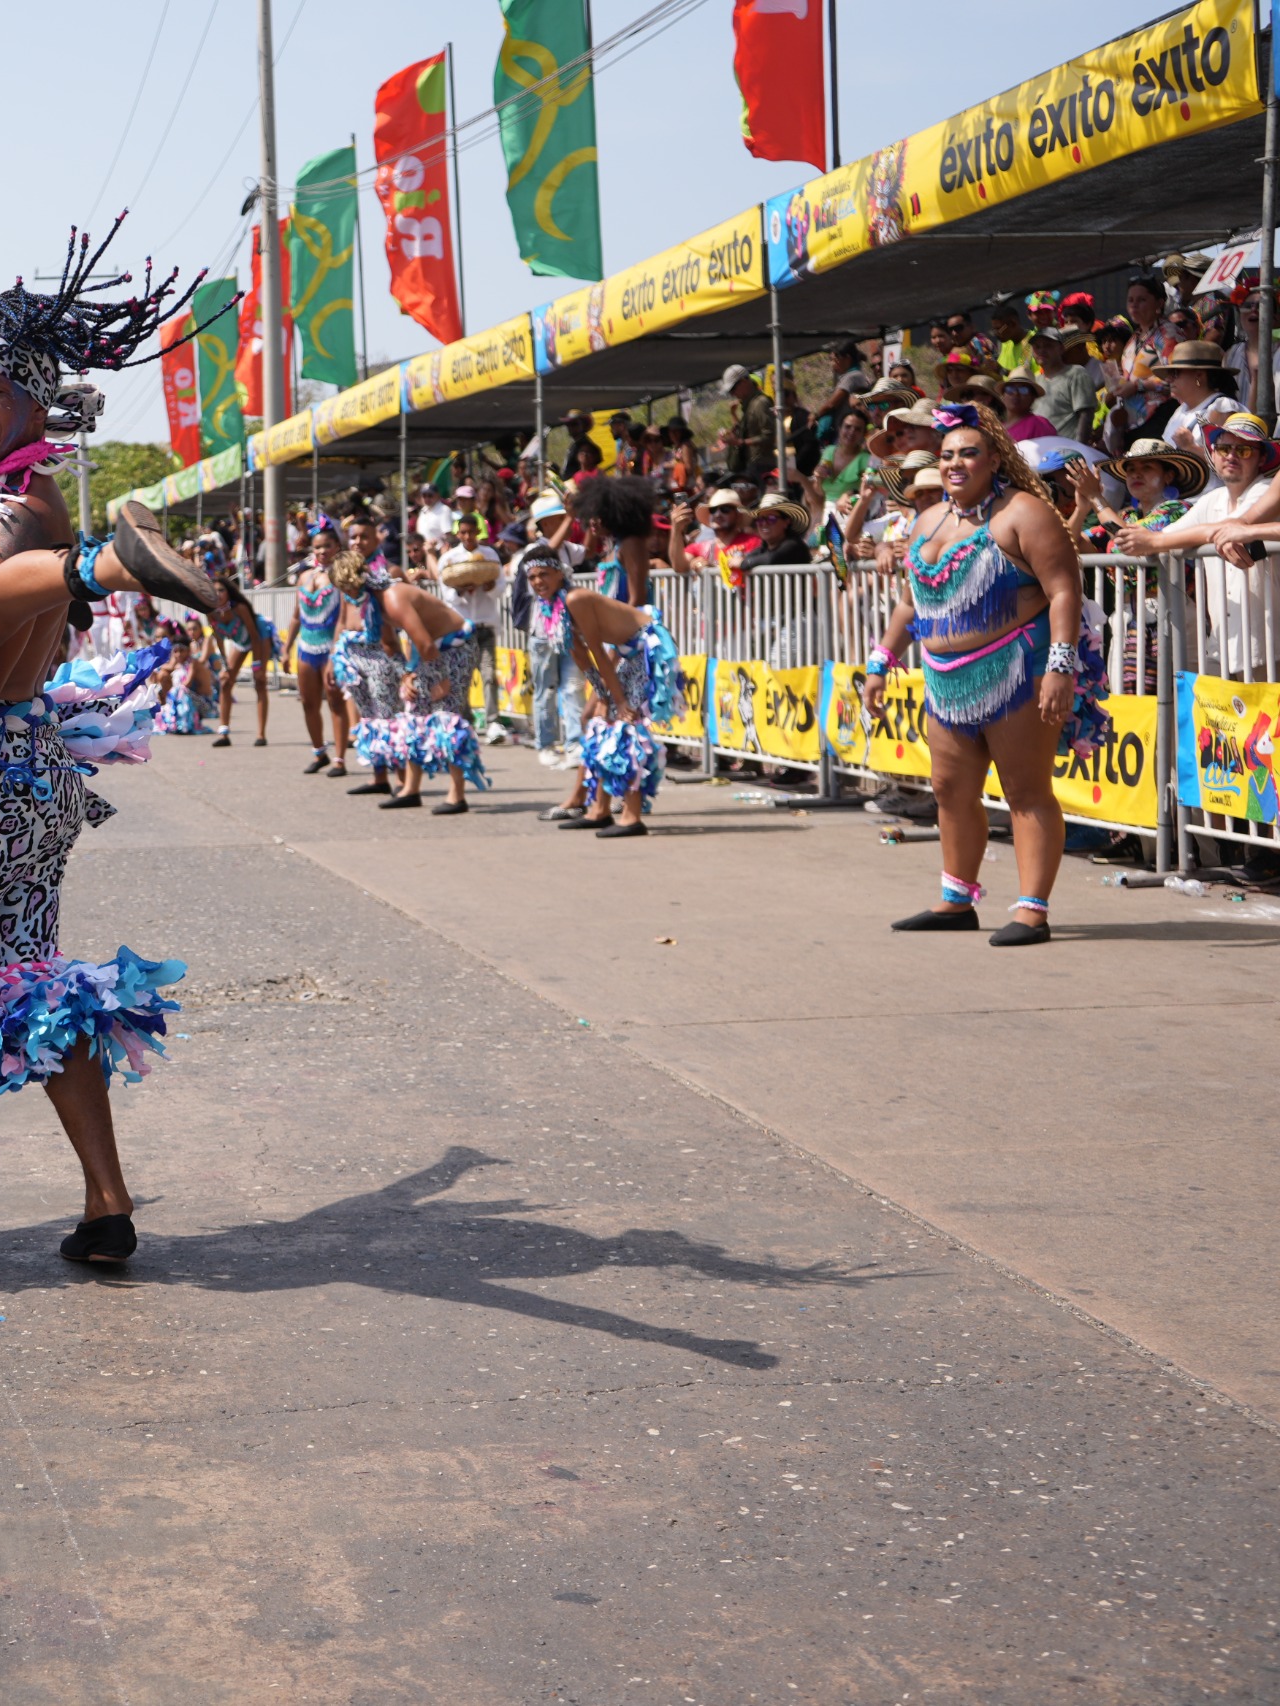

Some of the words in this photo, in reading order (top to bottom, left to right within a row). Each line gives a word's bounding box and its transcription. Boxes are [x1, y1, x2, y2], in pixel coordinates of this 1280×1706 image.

[940, 117, 1014, 198] éxito
[1028, 74, 1115, 163] éxito
[1132, 23, 1230, 120] éxito
[622, 272, 655, 327] éxito
[661, 253, 700, 311] éxito
[708, 230, 752, 292] éxito
[1208, 251, 1244, 284] 10
